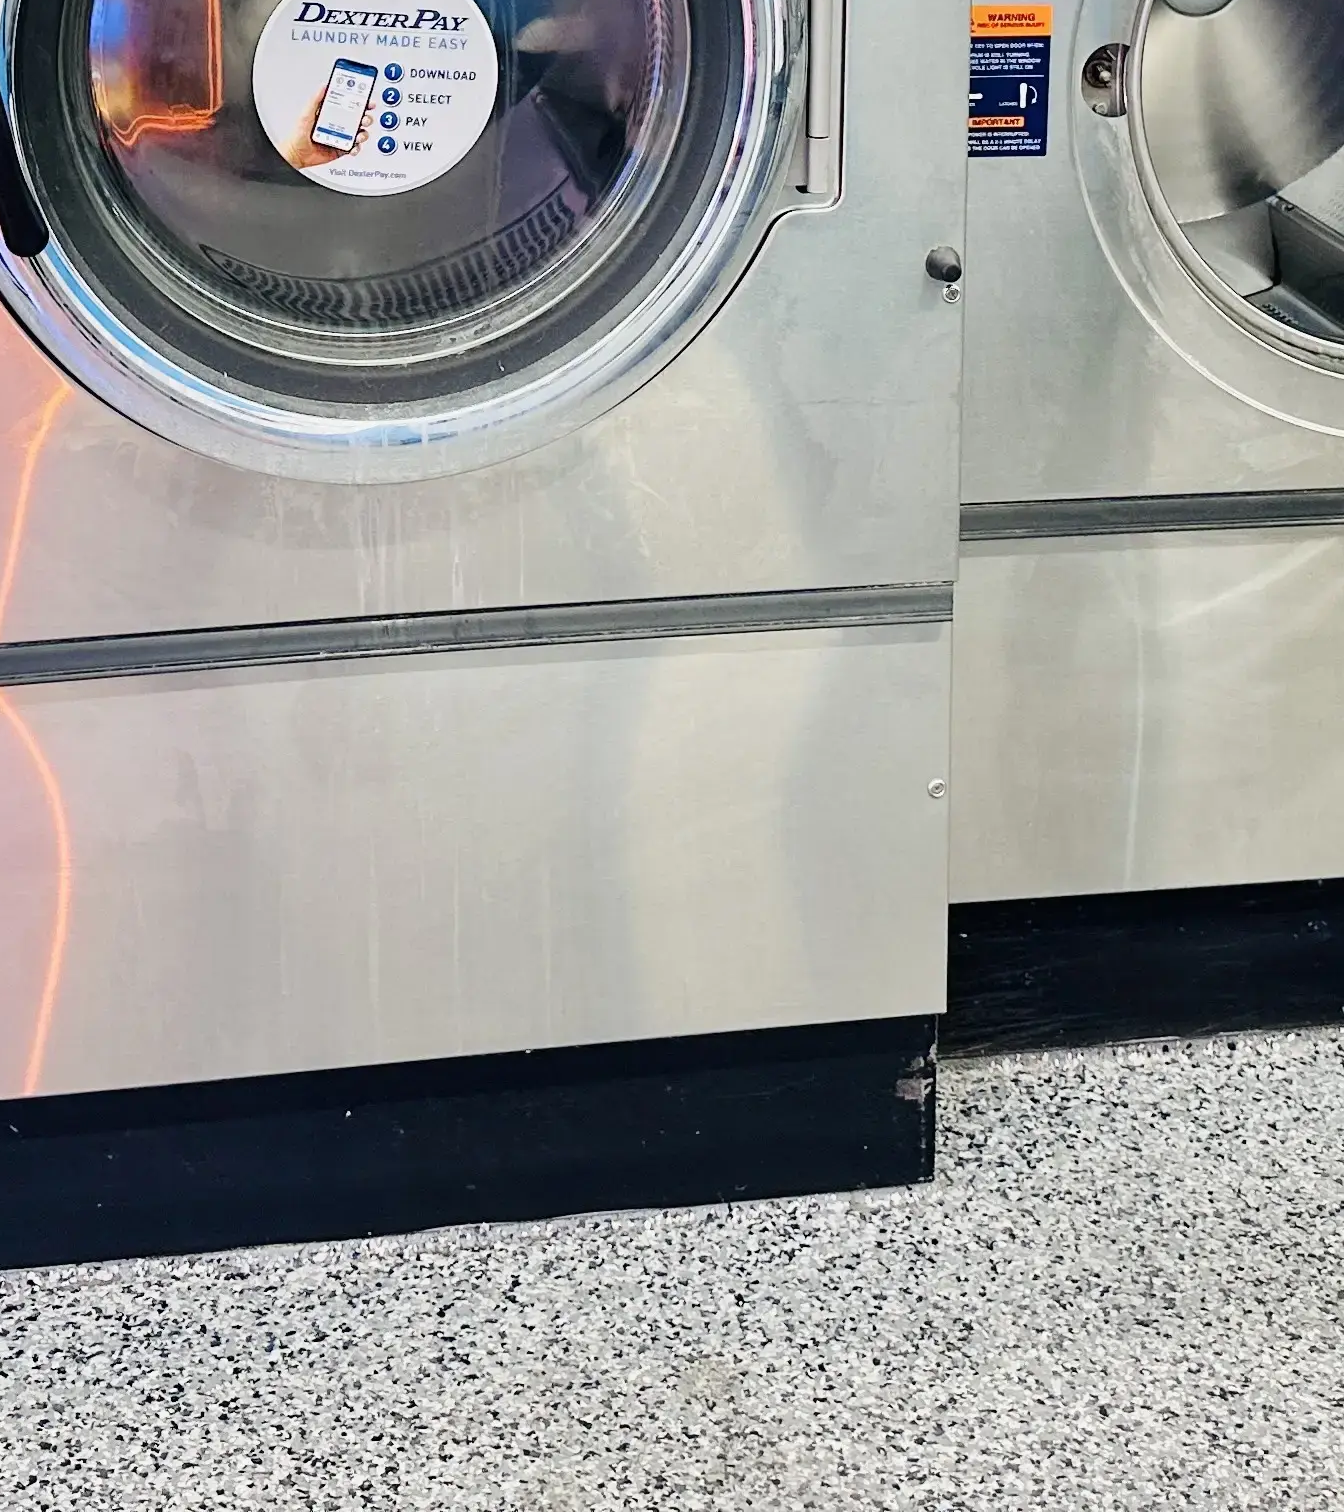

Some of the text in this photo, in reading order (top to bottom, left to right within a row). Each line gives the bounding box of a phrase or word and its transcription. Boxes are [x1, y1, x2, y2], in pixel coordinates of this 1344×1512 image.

[292, 29, 468, 50] LAUNDRY MADE EASY
[410, 69, 476, 81] DOWNLOAD
[408, 94, 451, 105] SELECT
[406, 117, 427, 126] PAY
[403, 142, 433, 151] VIEW
